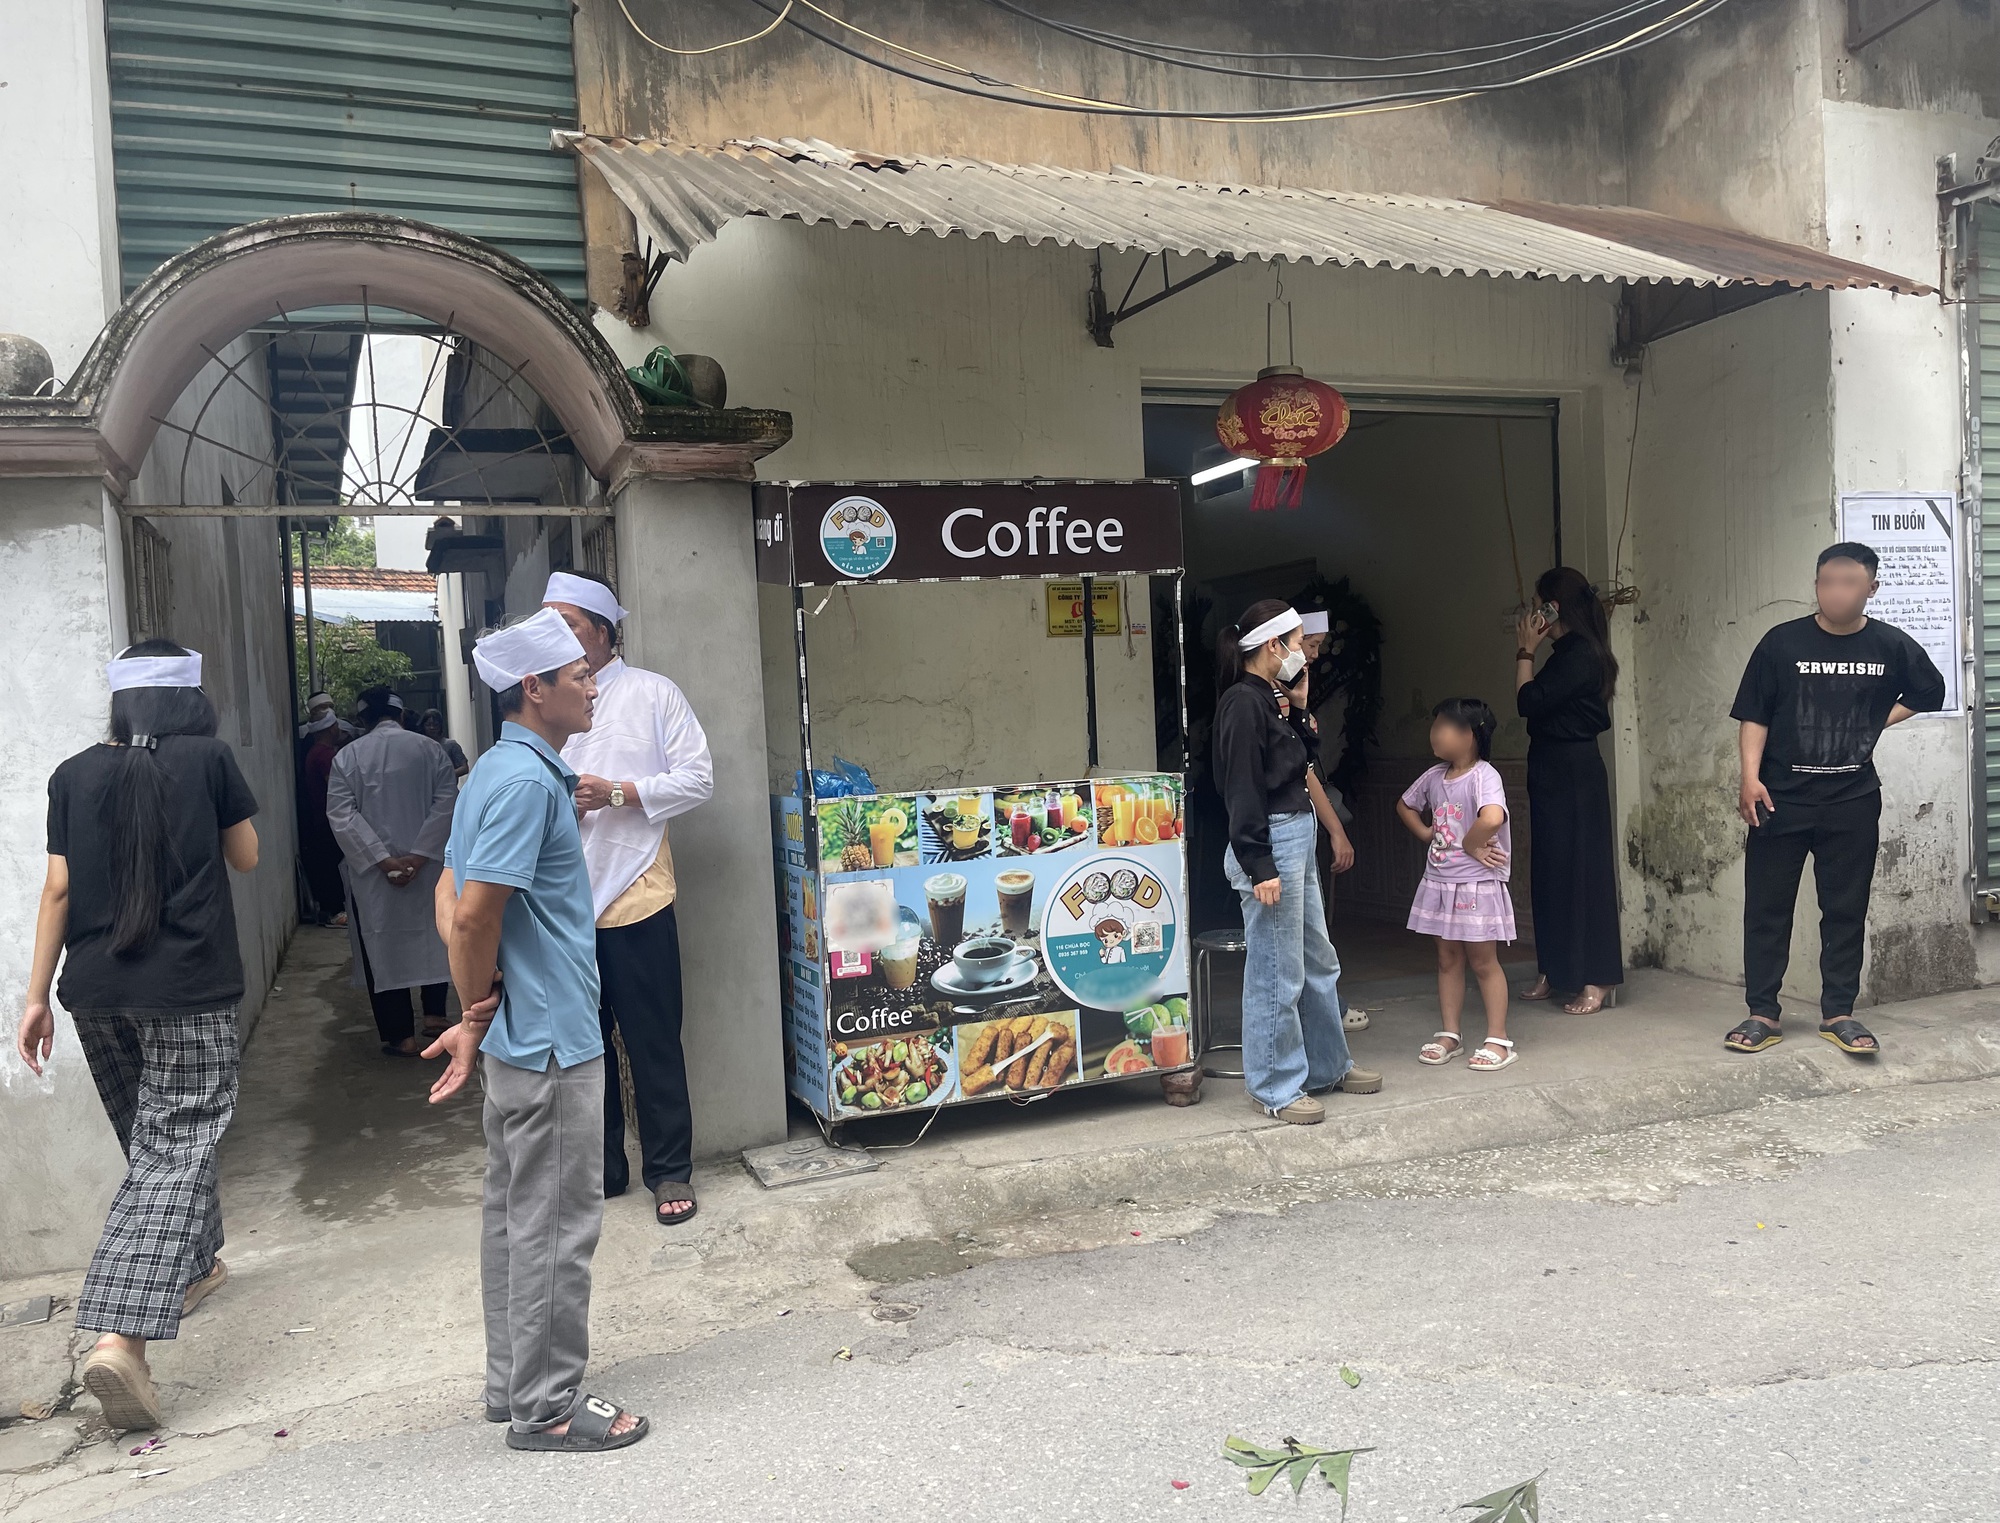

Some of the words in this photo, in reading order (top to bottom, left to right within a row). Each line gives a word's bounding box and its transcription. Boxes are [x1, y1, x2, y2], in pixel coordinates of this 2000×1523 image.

[1872, 514, 1890, 530] TIN
[1894, 509, 1925, 530] BUỒN
[941, 506, 1124, 558] Coffee
[1799, 661, 1885, 676] ERWEISHU
[837, 1008, 913, 1034] Coffee
